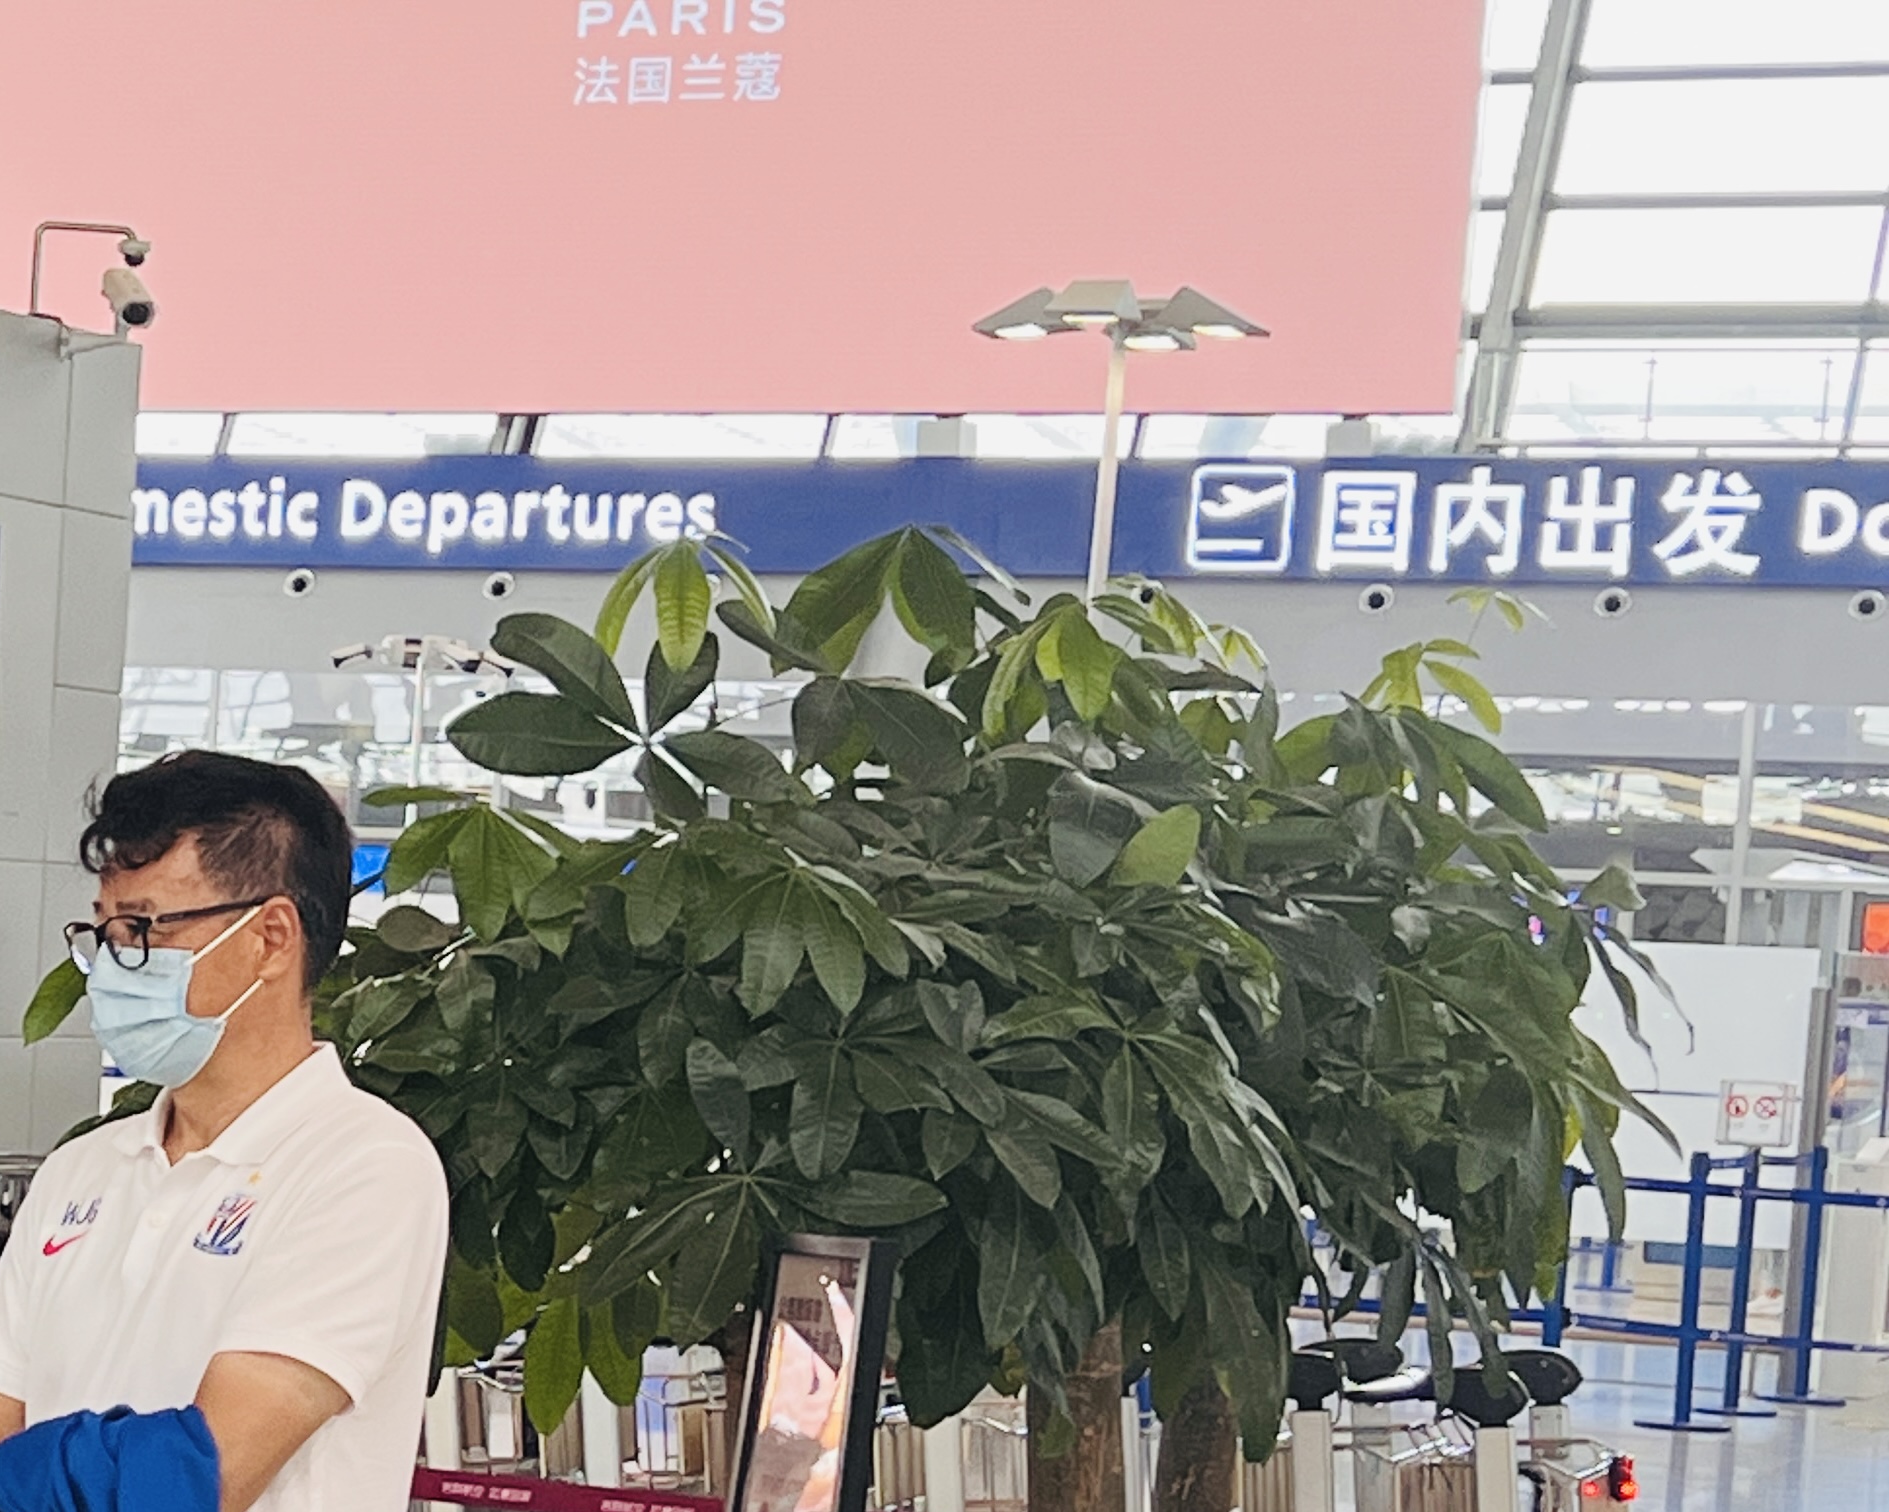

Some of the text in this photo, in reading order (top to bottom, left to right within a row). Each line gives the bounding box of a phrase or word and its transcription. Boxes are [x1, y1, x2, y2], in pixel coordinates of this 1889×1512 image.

[577, 0, 786, 38] PARIS
[573, 52, 783, 106] 法国兰蔻
[340, 478, 716, 556] Departures
[1315, 466, 1762, 577] 国内出发
